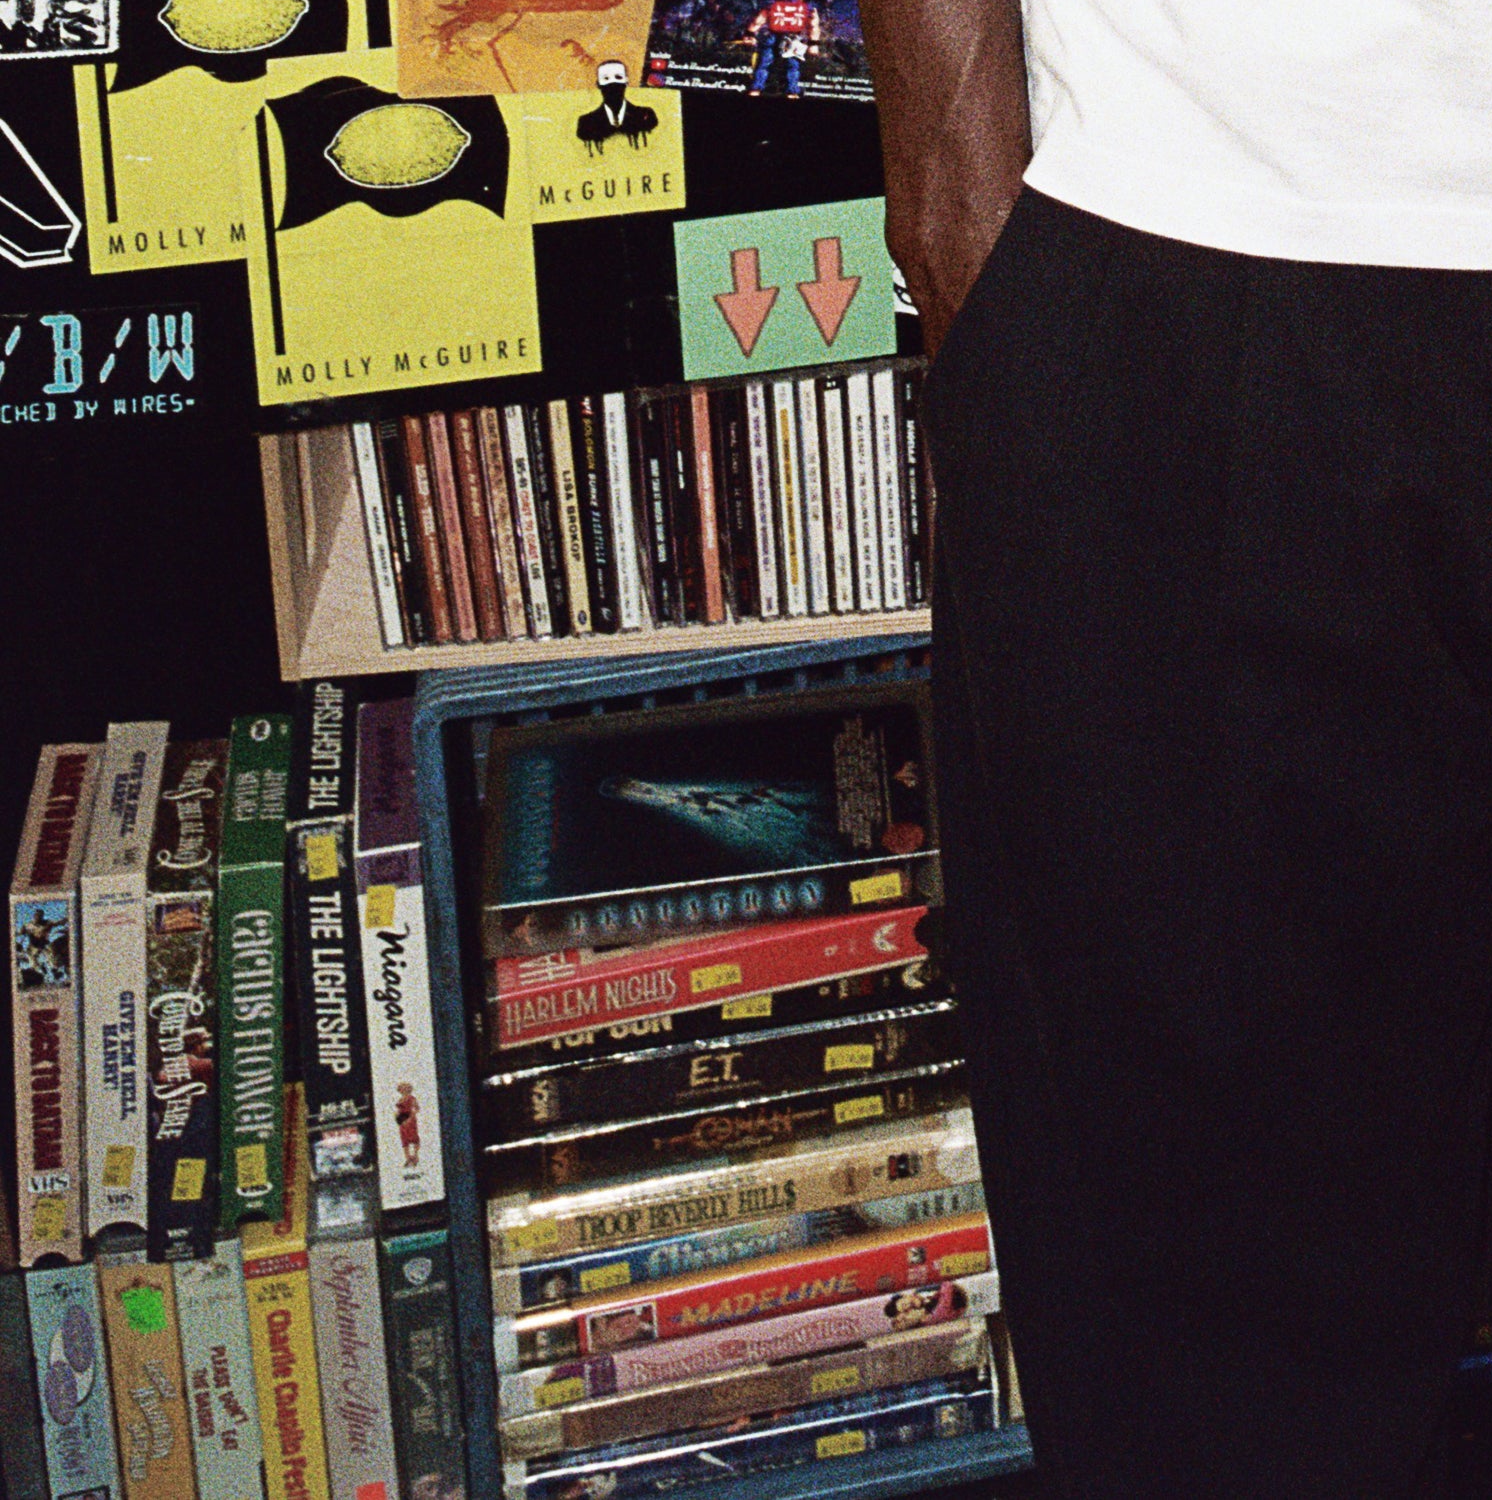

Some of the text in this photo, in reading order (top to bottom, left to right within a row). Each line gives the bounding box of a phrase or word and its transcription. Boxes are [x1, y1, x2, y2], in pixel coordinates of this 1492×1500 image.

[539, 174, 672, 206] McGUIRE
[109, 226, 206, 255] MOLLY
[277, 338, 529, 387] MOLLY McGUIRE
[1, 400, 98, 423] CHED BY
[562, 470, 581, 562] LISA BROKOP
[310, 892, 352, 1075] THE LIGHTSHIP
[374, 926, 413, 1051] Niagara
[505, 989, 598, 1035] HARLEM
[604, 969, 677, 1011] NIGHTS
[690, 1053, 740, 1087] E.T.
[577, 1209, 641, 1246] TROOP
[649, 1195, 730, 1231] BEVERLY
[679, 1270, 859, 1327] MADELINE
[323, 1255, 381, 1459] September Affair
[266, 1309, 309, 1500] Charlie Chaplin Festi
